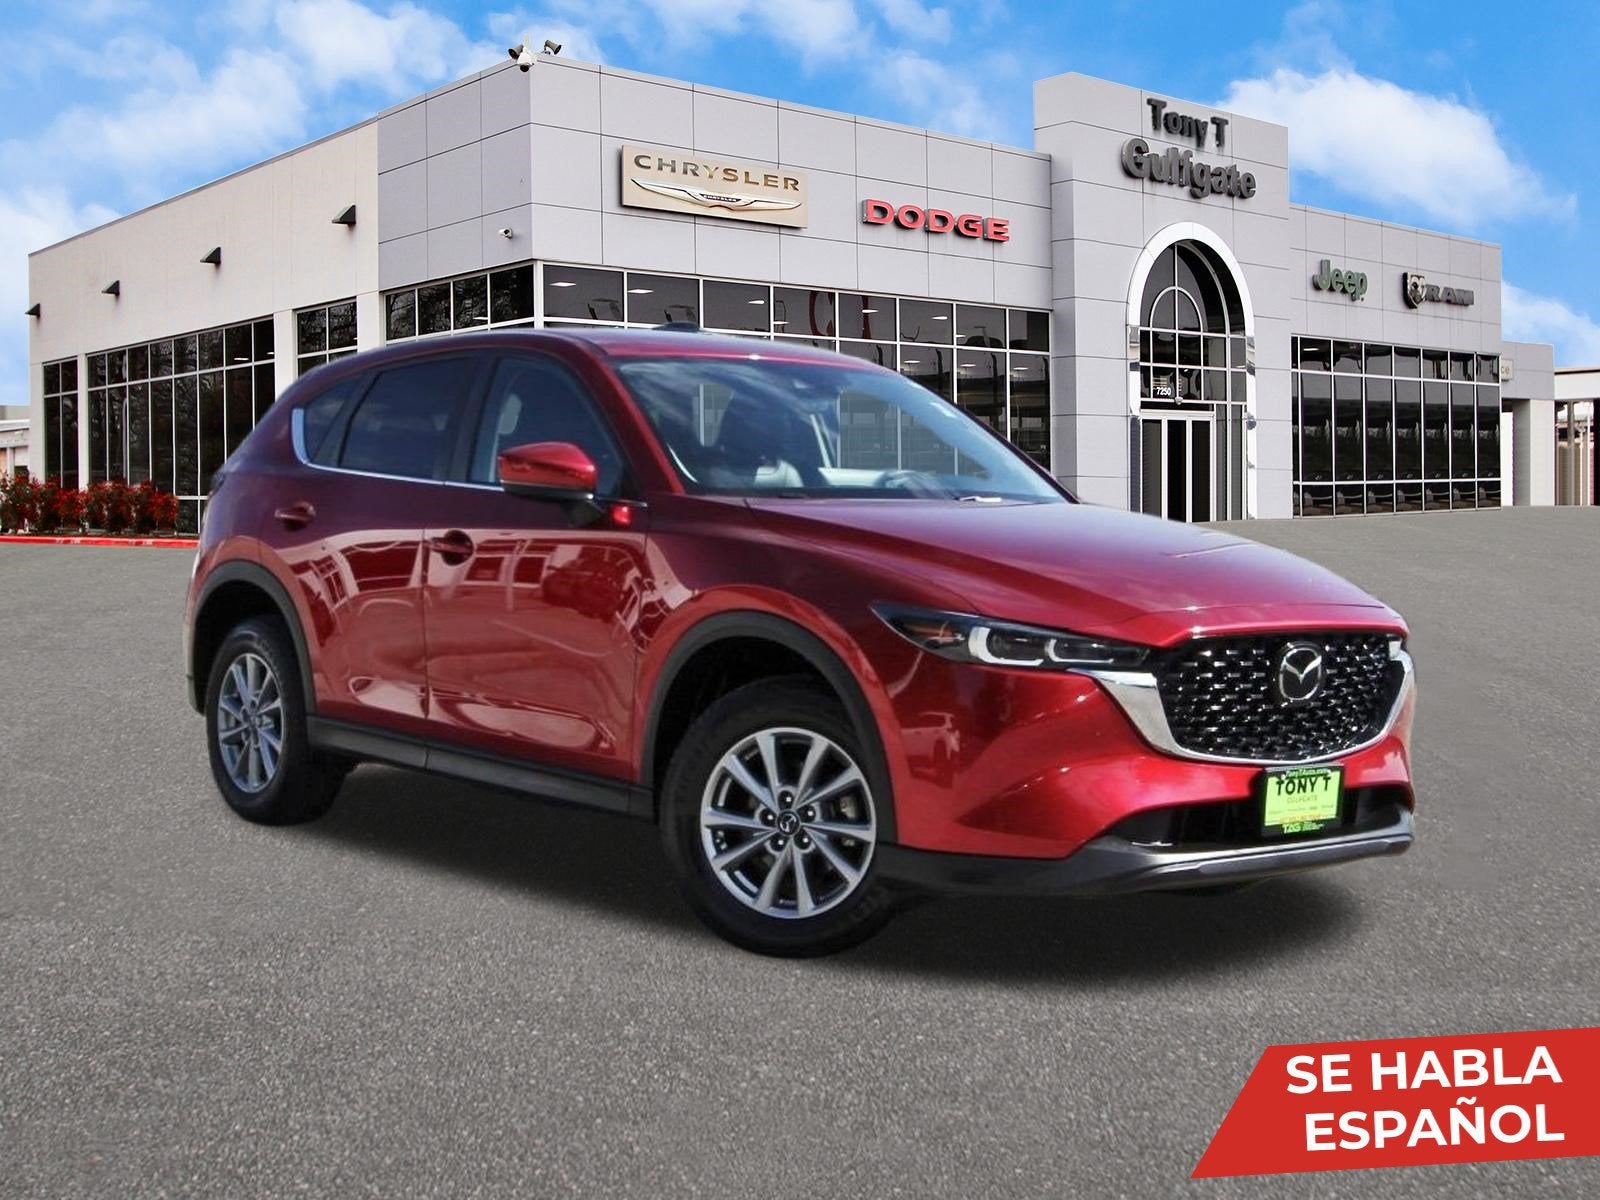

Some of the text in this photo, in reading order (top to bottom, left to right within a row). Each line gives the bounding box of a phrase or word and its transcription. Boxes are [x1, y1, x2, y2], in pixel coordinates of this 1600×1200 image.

[1146, 98, 1229, 148] Tony T
[633, 154, 800, 192] CHRYSLER
[1121, 138, 1257, 199] Gulfgate
[862, 199, 1010, 242] DODGE
[1312, 259, 1368, 302] Jeep
[1425, 284, 1475, 307] RAM
[1276, 776, 1331, 796] TONY T
